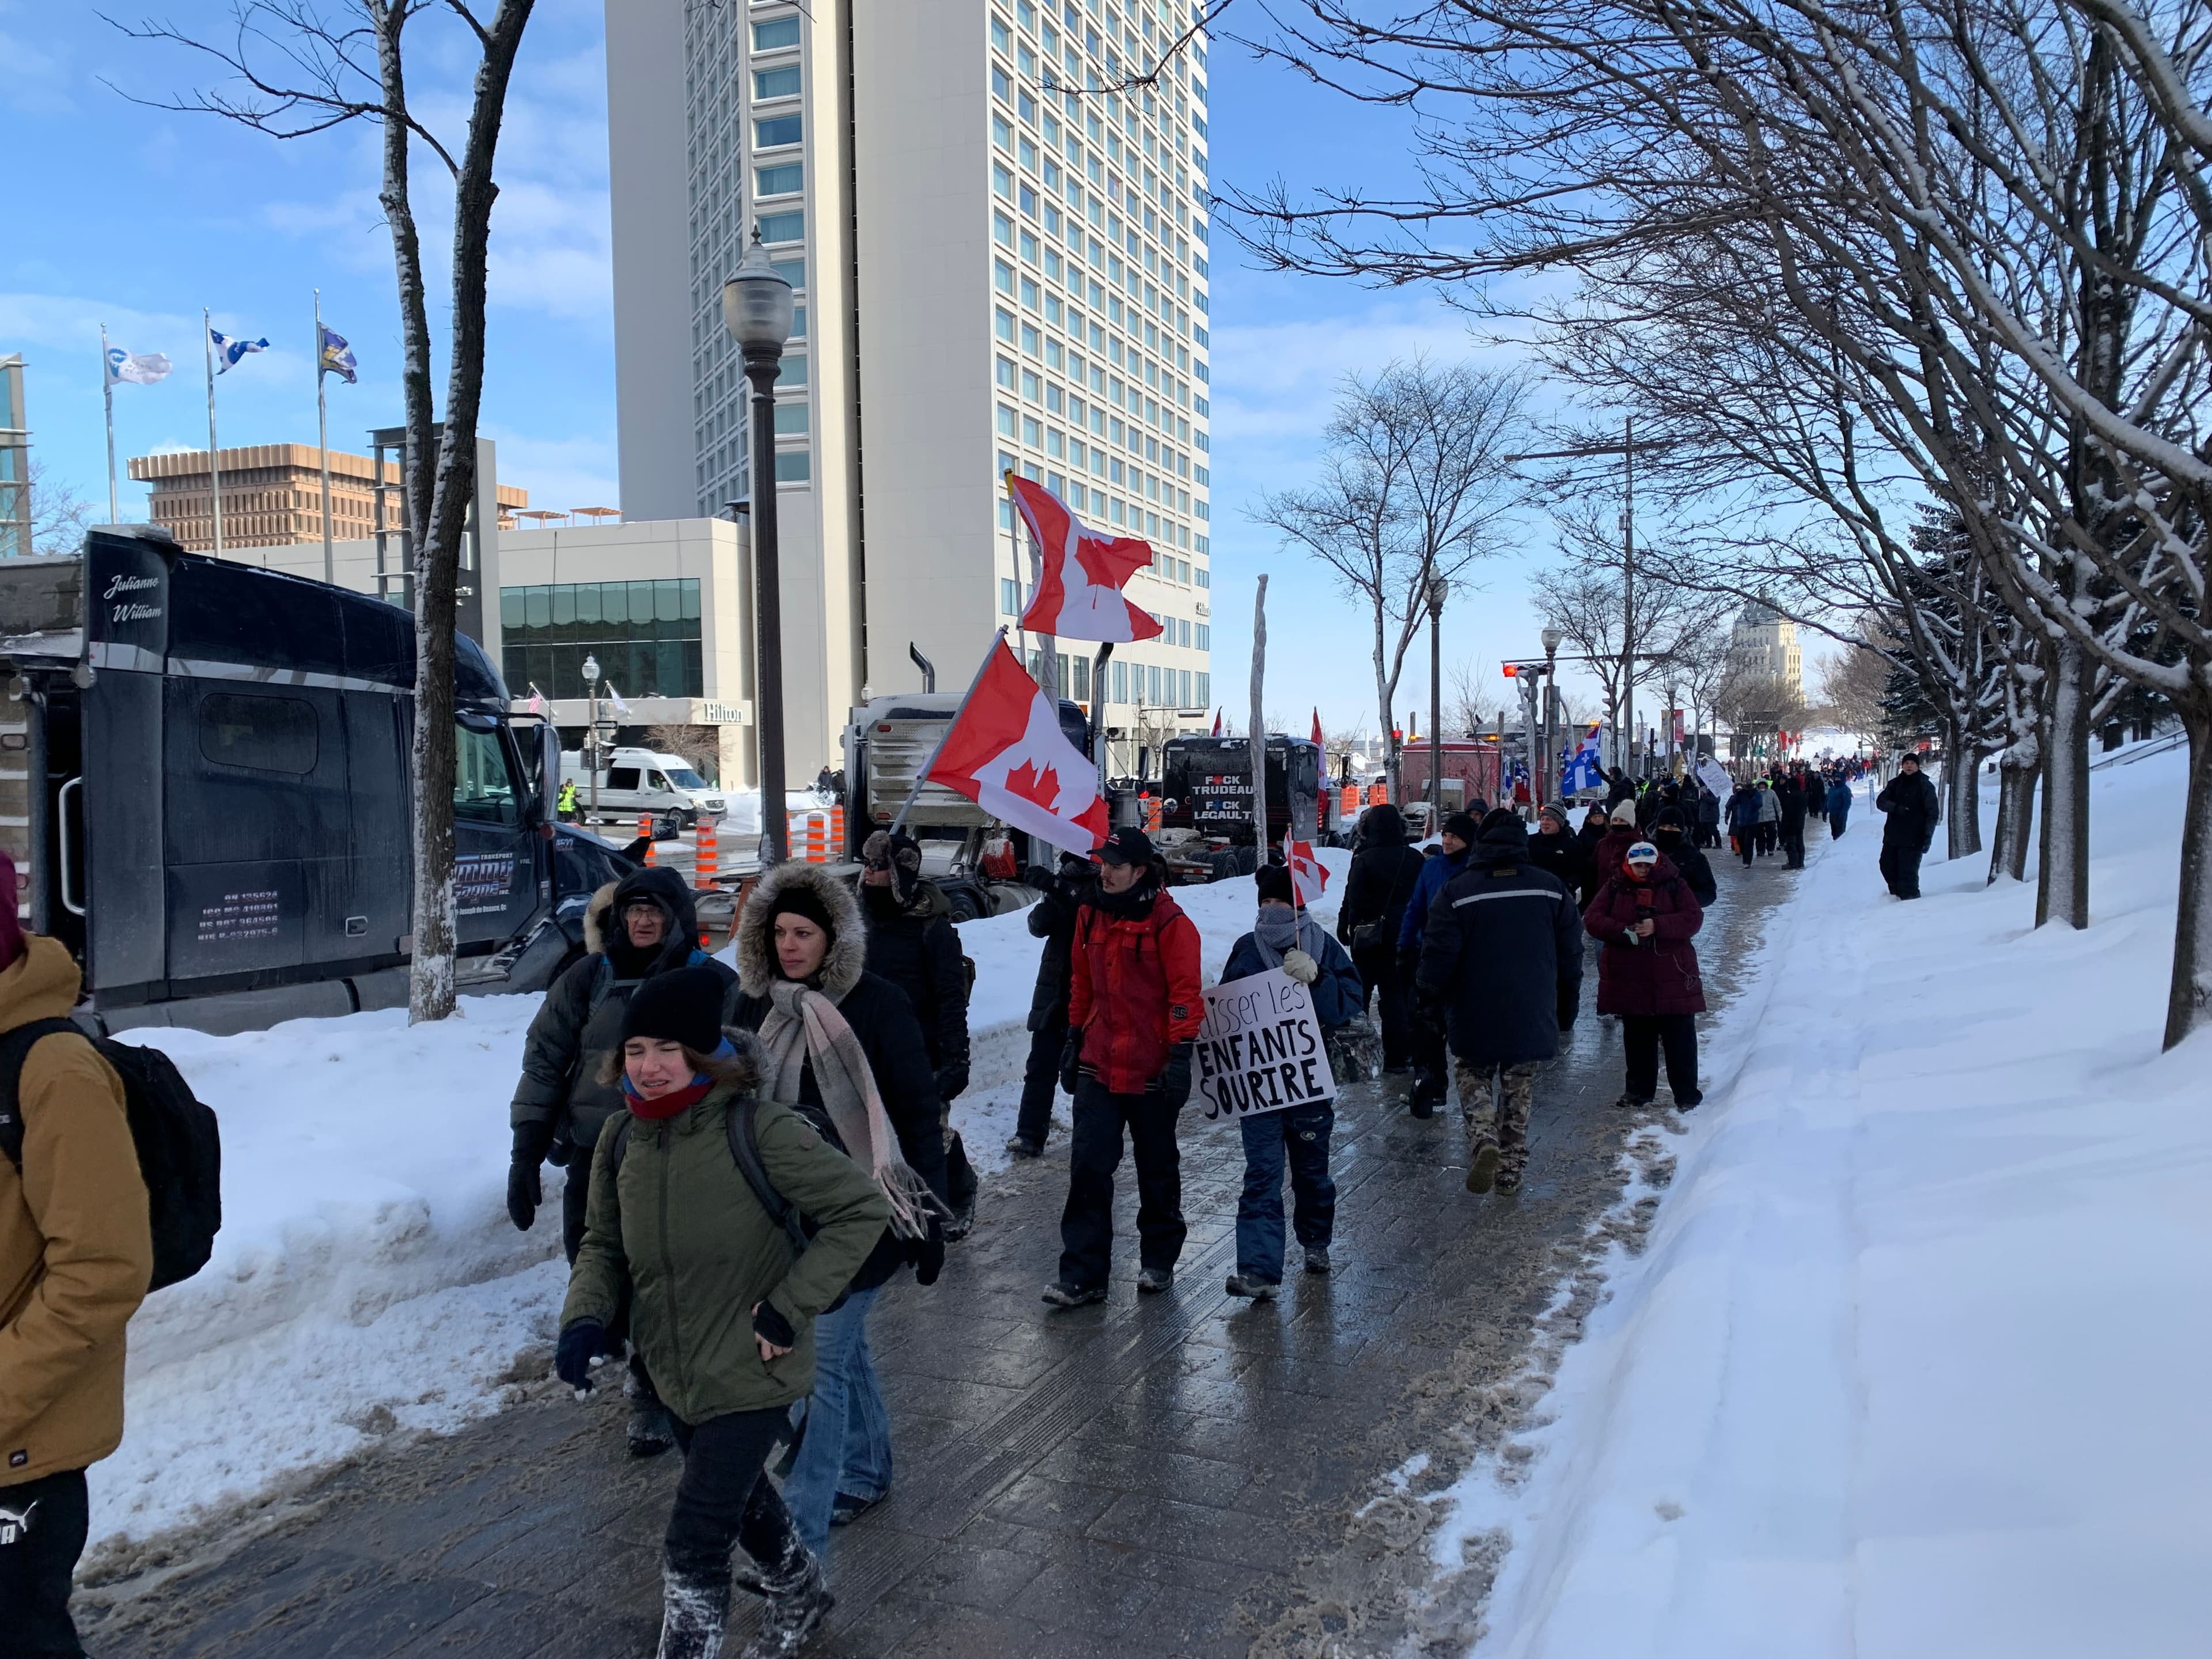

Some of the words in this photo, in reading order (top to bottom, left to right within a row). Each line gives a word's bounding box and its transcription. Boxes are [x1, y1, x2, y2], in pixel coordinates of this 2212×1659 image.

[104, 575, 159, 599] Julianne
[113, 604, 161, 622] William
[704, 703, 743, 722] Hilton
[1192, 786, 1253, 794] TRUDEAU
[1194, 810, 1252, 820] LEGAULT
[1195, 992, 1260, 1041] aisser
[1267, 981, 1305, 1014] Les
[1196, 1018, 1316, 1077] ENFANTS
[1200, 1058, 1324, 1120] SOURIRE
